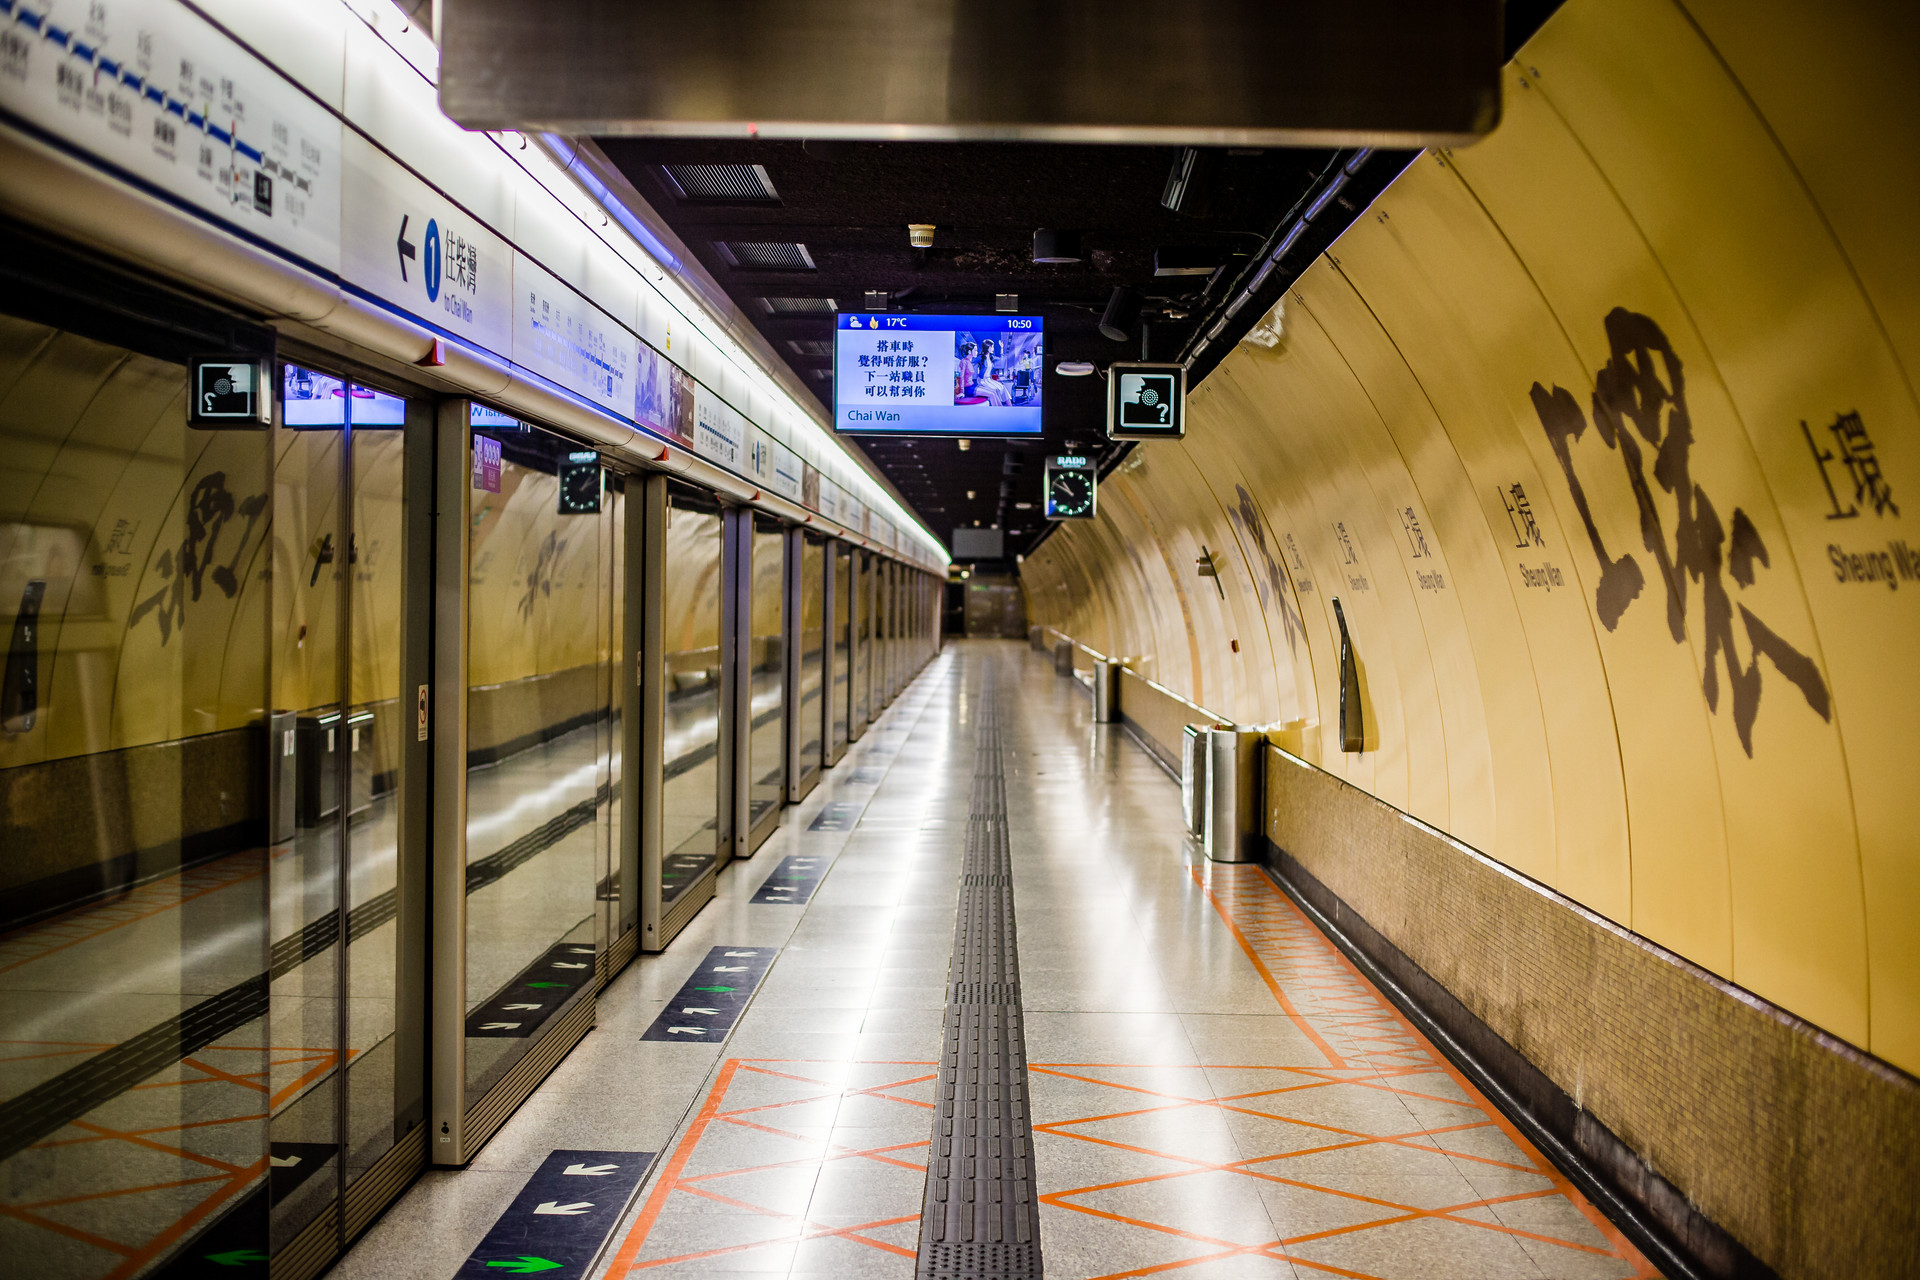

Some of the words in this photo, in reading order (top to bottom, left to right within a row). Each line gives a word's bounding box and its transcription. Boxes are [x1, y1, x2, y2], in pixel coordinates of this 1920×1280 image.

[444, 228, 476, 296] 往柴灣
[444, 293, 450, 312] to
[451, 294, 462, 318] Chai
[462, 299, 472, 324] Wan
[1008, 319, 1032, 329] 10:50
[876, 340, 914, 353] 搭車時
[864, 370, 926, 383] 下一站職員
[864, 385, 926, 398] 可以幫到你
[848, 410, 872, 421] Chai
[874, 410, 900, 421] Wan
[1056, 456, 1086, 465] RADO
[1801, 409, 1900, 520] 上環
[1497, 481, 1546, 549] 上環
[1519, 561, 1552, 592] Sheung
[1547, 564, 1566, 588] Wan
[1826, 543, 1898, 591] Sheung
[1888, 538, 1920, 582] Wa
[1416, 570, 1438, 594] Sheung
[1431, 570, 1446, 590] Wan
